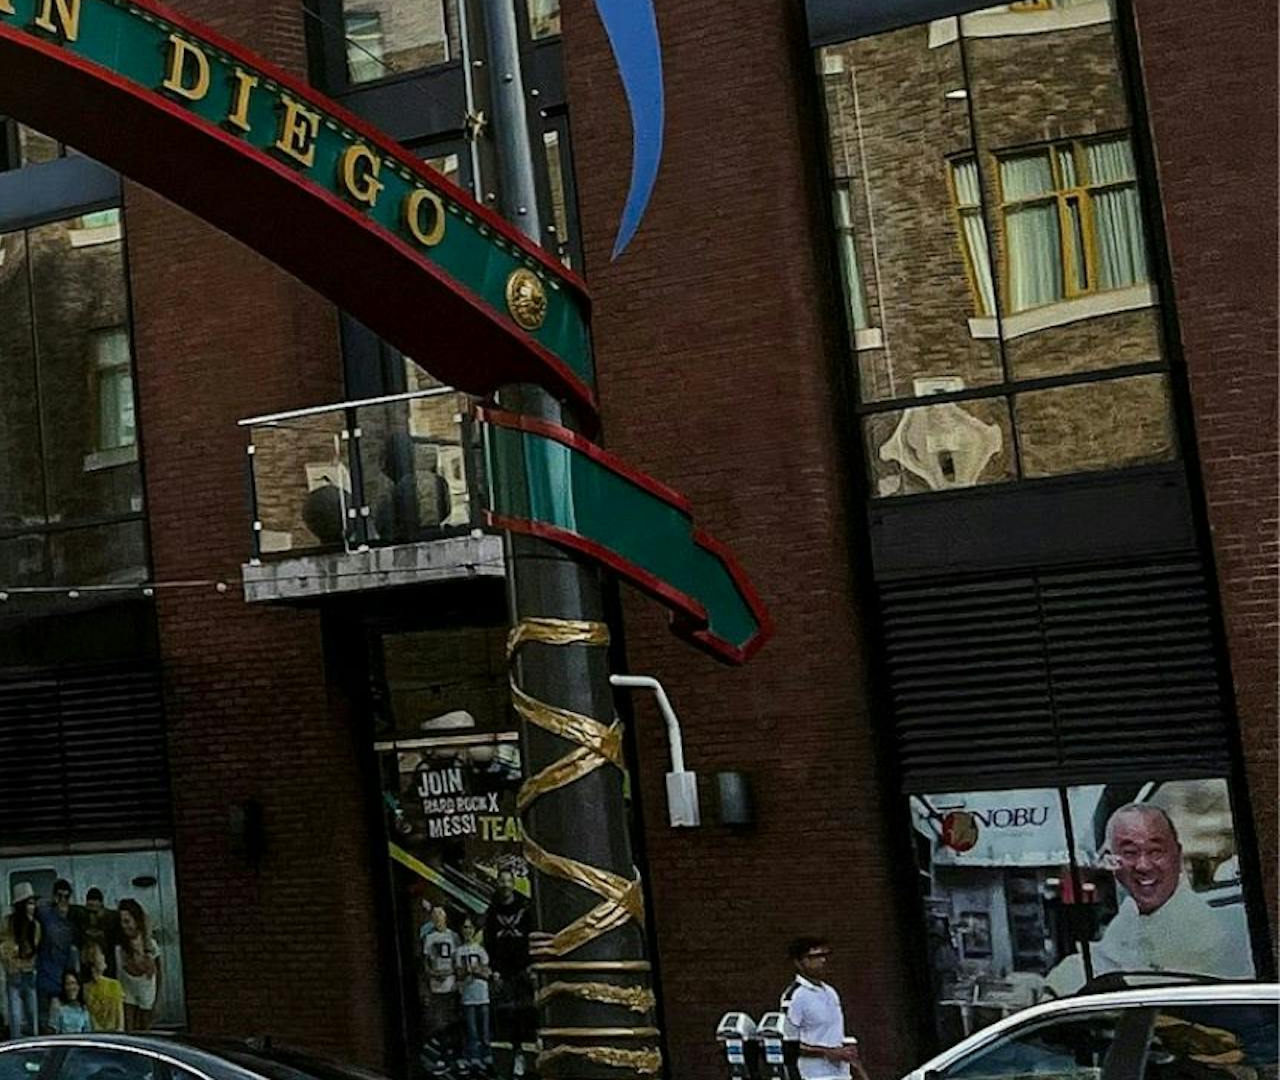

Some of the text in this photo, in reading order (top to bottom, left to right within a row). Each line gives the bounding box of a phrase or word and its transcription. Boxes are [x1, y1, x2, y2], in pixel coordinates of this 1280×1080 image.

[161, 34, 446, 248] DIEGO
[417, 767, 464, 798] JOIN
[423, 791, 500, 814] HARD ROCK X
[428, 813, 477, 838] MESSI
[967, 806, 1050, 828] NOBU
